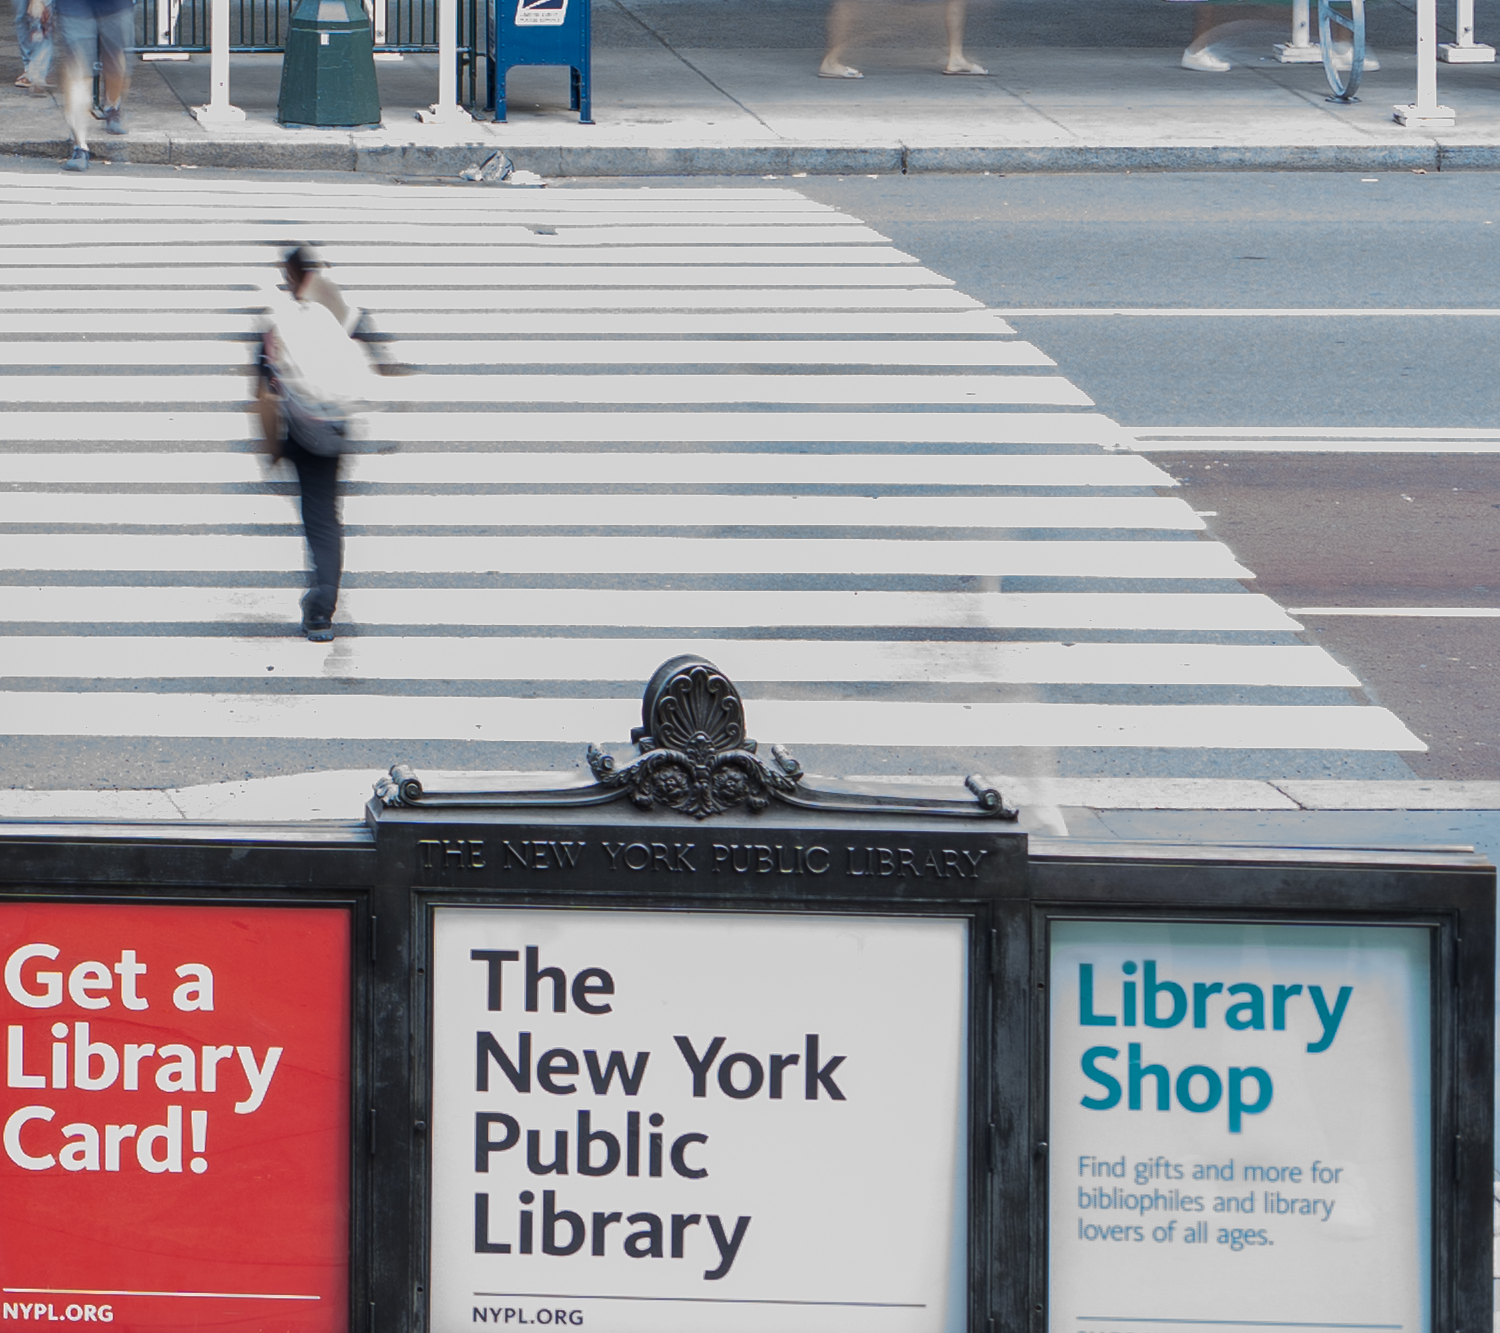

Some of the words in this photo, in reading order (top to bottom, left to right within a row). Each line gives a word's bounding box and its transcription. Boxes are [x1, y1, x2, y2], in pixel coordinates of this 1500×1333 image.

[417, 839, 487, 870] THE
[503, 839, 587, 871] NEW
[602, 841, 696, 873] YORK
[713, 843, 831, 875] PUBLIC
[847, 845, 989, 879] LIBRARY
[5, 943, 148, 1012] Get
[172, 964, 215, 1012] a
[471, 946, 615, 1015] The
[1078, 960, 1354, 1055] Library
[7, 1022, 284, 1116] Library
[475, 1031, 650, 1096] New
[672, 1034, 847, 1101] York
[1080, 1043, 1274, 1134] Shop
[2, 1105, 208, 1174] Card!
[475, 1109, 709, 1180] Public
[1079, 1155, 1126, 1178] Find
[1134, 1156, 1184, 1186] gifts
[1192, 1158, 1234, 1182] and
[1243, 1165, 1303, 1184] more
[1310, 1160, 1343, 1184] for
[474, 1190, 752, 1281] Library
[1077, 1186, 1205, 1216] bibliophiles
[1212, 1190, 1255, 1214] and
[1264, 1191, 1334, 1222] library
[1078, 1218, 1144, 1242] lovers
[1152, 1220, 1177, 1243] of
[1184, 1222, 1208, 1244] all
[1216, 1228, 1274, 1252] ages.
[2, 1302, 114, 1323] NYPL.ORG
[472, 1307, 584, 1326] NYPL.ORG
